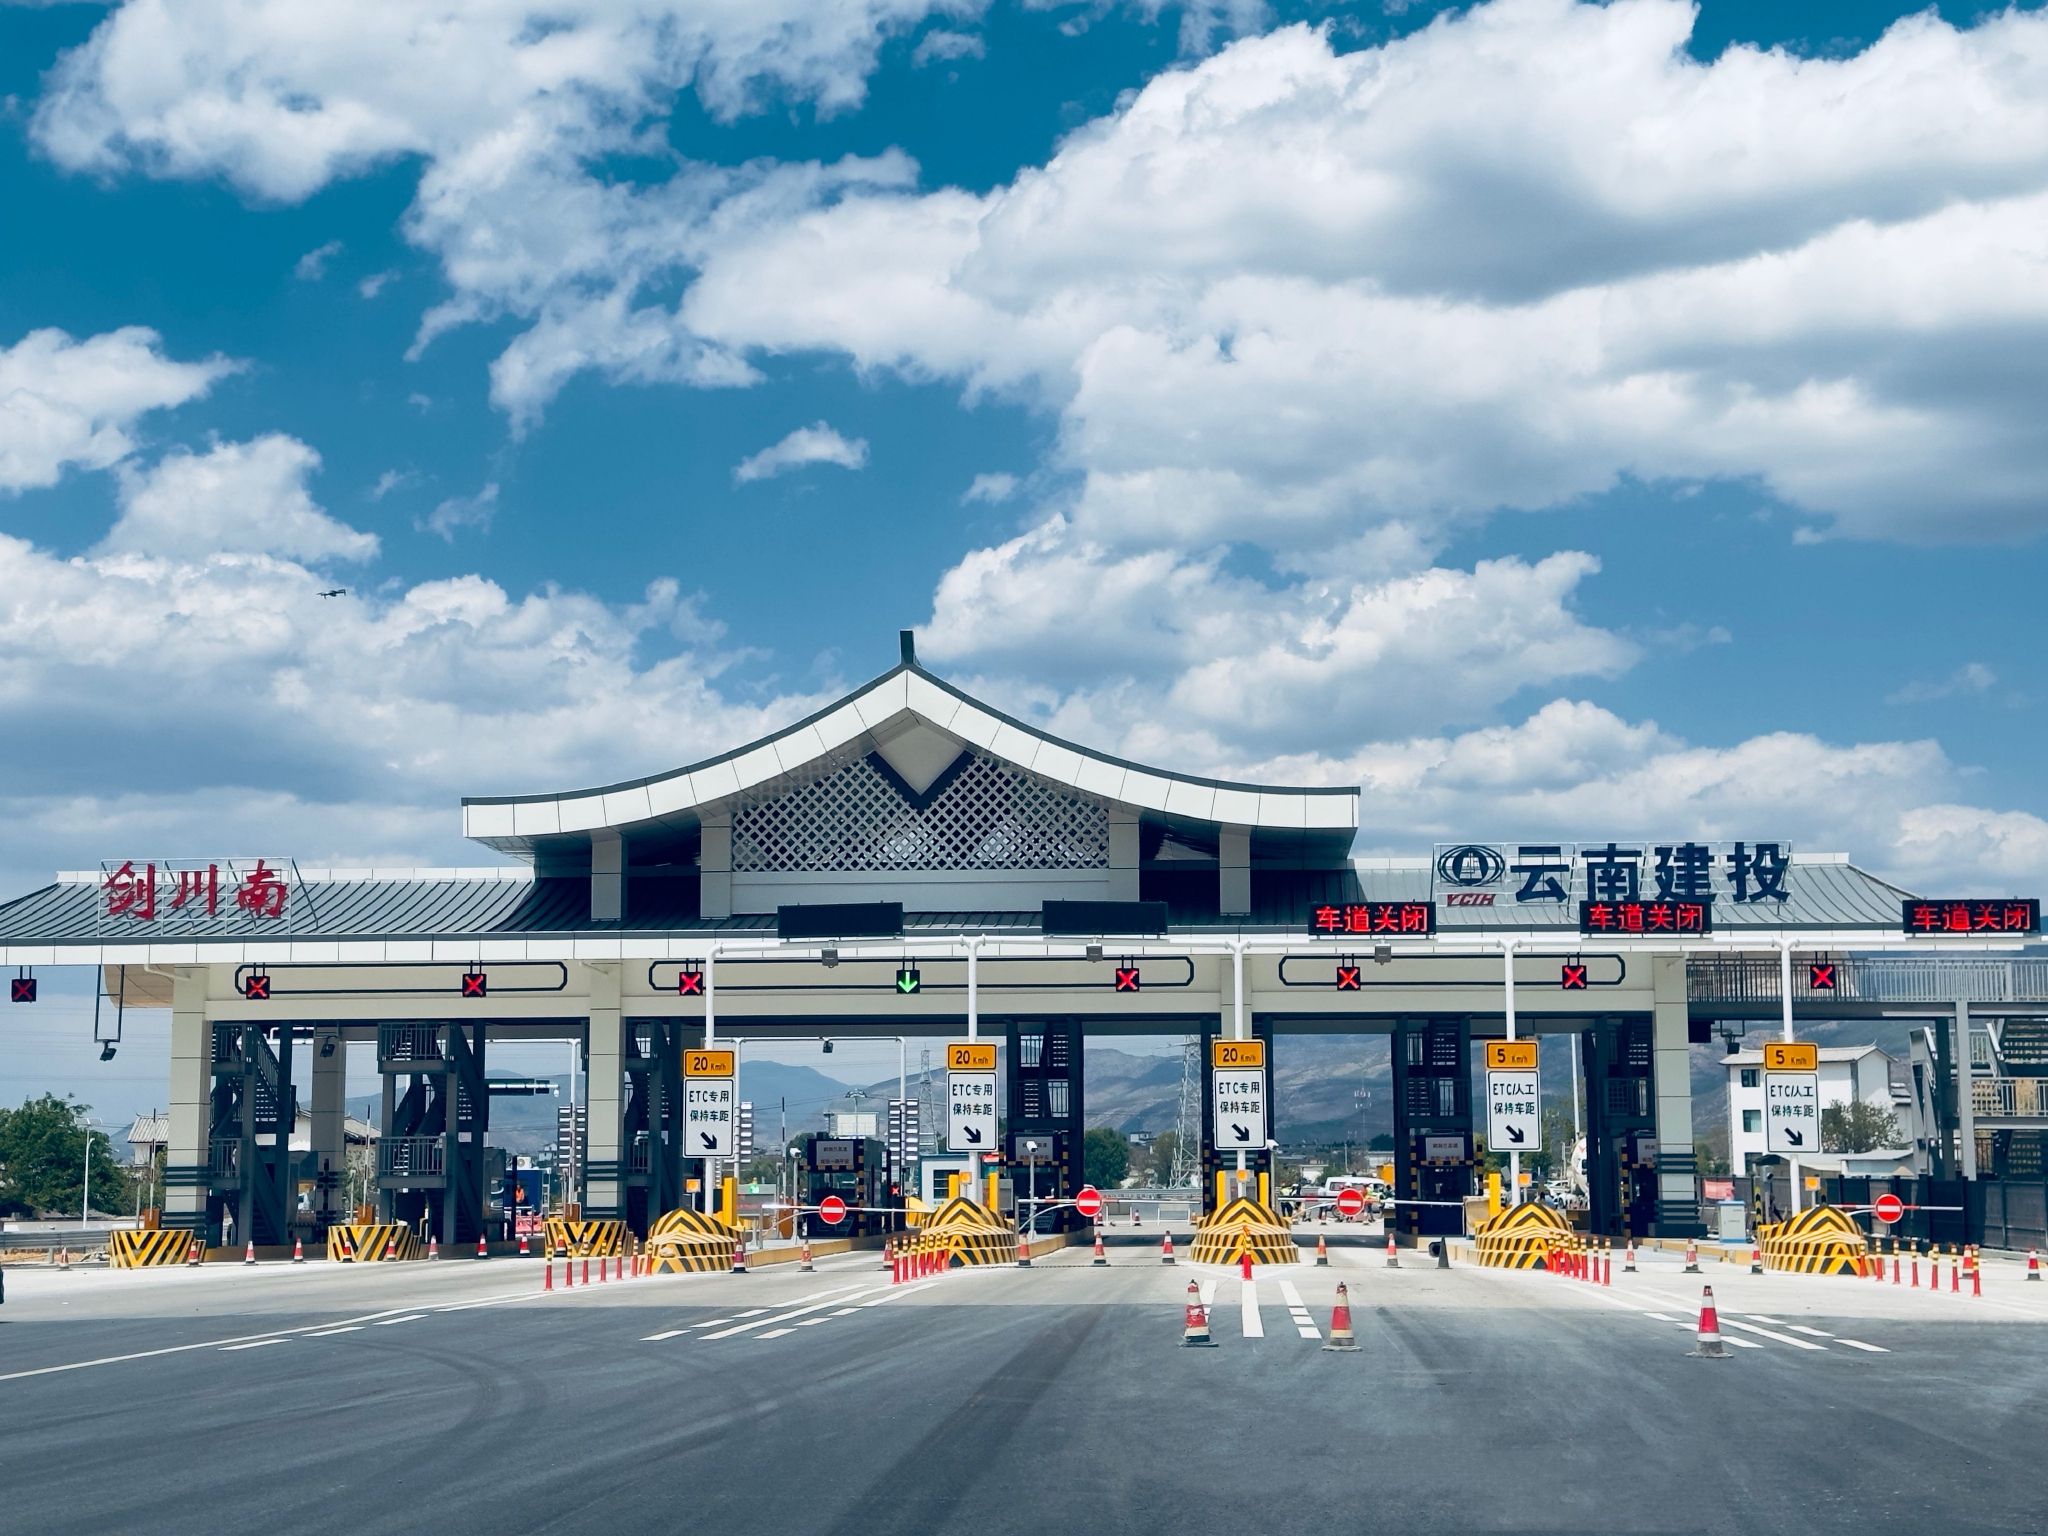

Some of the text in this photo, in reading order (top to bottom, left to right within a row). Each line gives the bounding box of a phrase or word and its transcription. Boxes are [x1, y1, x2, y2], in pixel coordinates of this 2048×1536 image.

[1510, 842, 1794, 903] 云南建投
[101, 859, 289, 920] 剑川南
[1315, 905, 1428, 932] 车道关闭
[1588, 903, 1703, 931] 车道关闭
[1912, 903, 2031, 931] 车道关闭
[955, 1049, 970, 1065] 20
[1222, 1047, 1238, 1063] 20
[1497, 1048, 1506, 1063] 5
[1775, 1049, 1785, 1065] 5
[693, 1056, 708, 1071] 20
[952, 1084, 993, 1096] ETC专用
[1218, 1081, 1260, 1094] ETC专用
[1492, 1083, 1535, 1096] ETC/人工
[1770, 1085, 1814, 1097] ETC/人工
[689, 1090, 729, 1103] ETC专用
[952, 1103, 993, 1116] 保持车距
[1219, 1101, 1260, 1114] 保持车距
[1493, 1101, 1535, 1115] 保持车距
[1771, 1104, 1814, 1117] 保持车距
[690, 1109, 729, 1122] 保持车距
